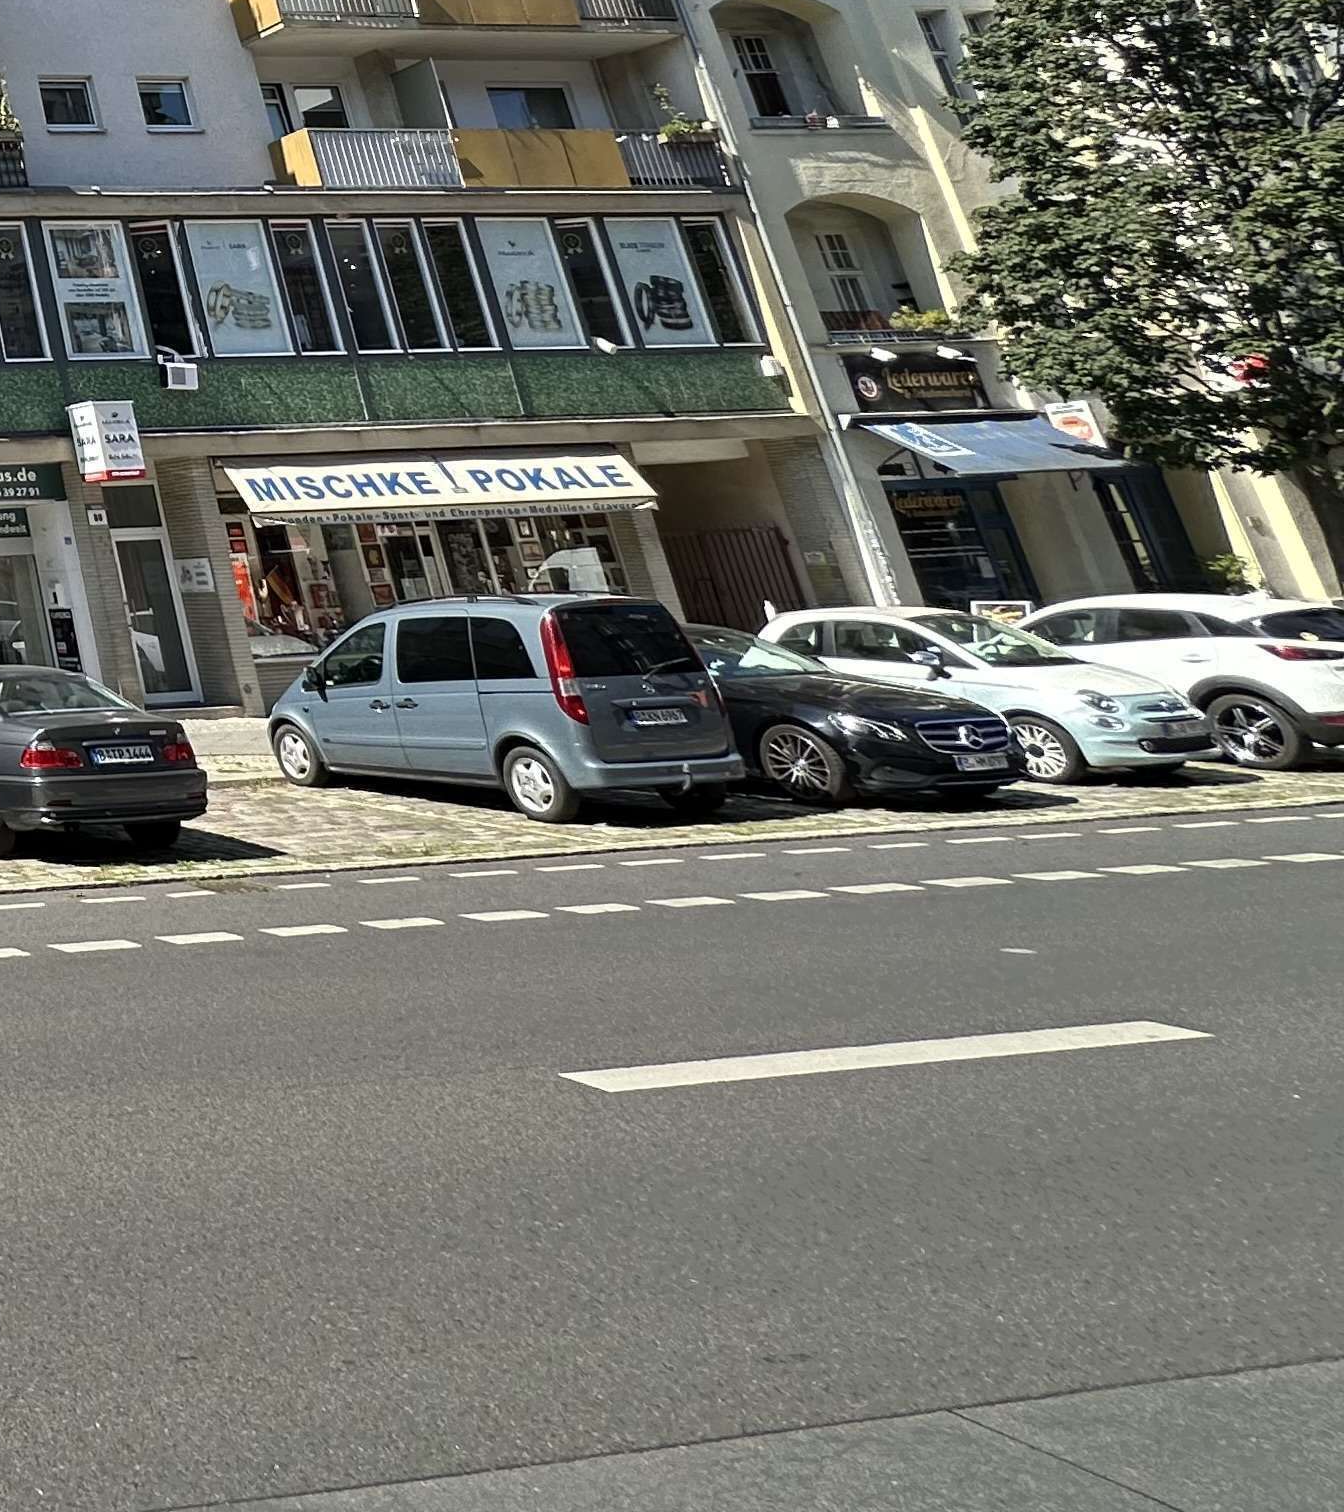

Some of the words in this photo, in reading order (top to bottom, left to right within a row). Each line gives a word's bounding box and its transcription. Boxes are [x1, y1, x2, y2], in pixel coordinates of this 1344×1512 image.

[105, 433, 136, 444] SARA
[245, 471, 441, 502] MISCHKE
[465, 465, 633, 493] POKALE
[3, 488, 15, 497] 39
[333, 513, 374, 522] Pokale
[425, 510, 446, 518] und
[529, 504, 585, 514] Medaillen
[593, 502, 638, 512] Gravure
